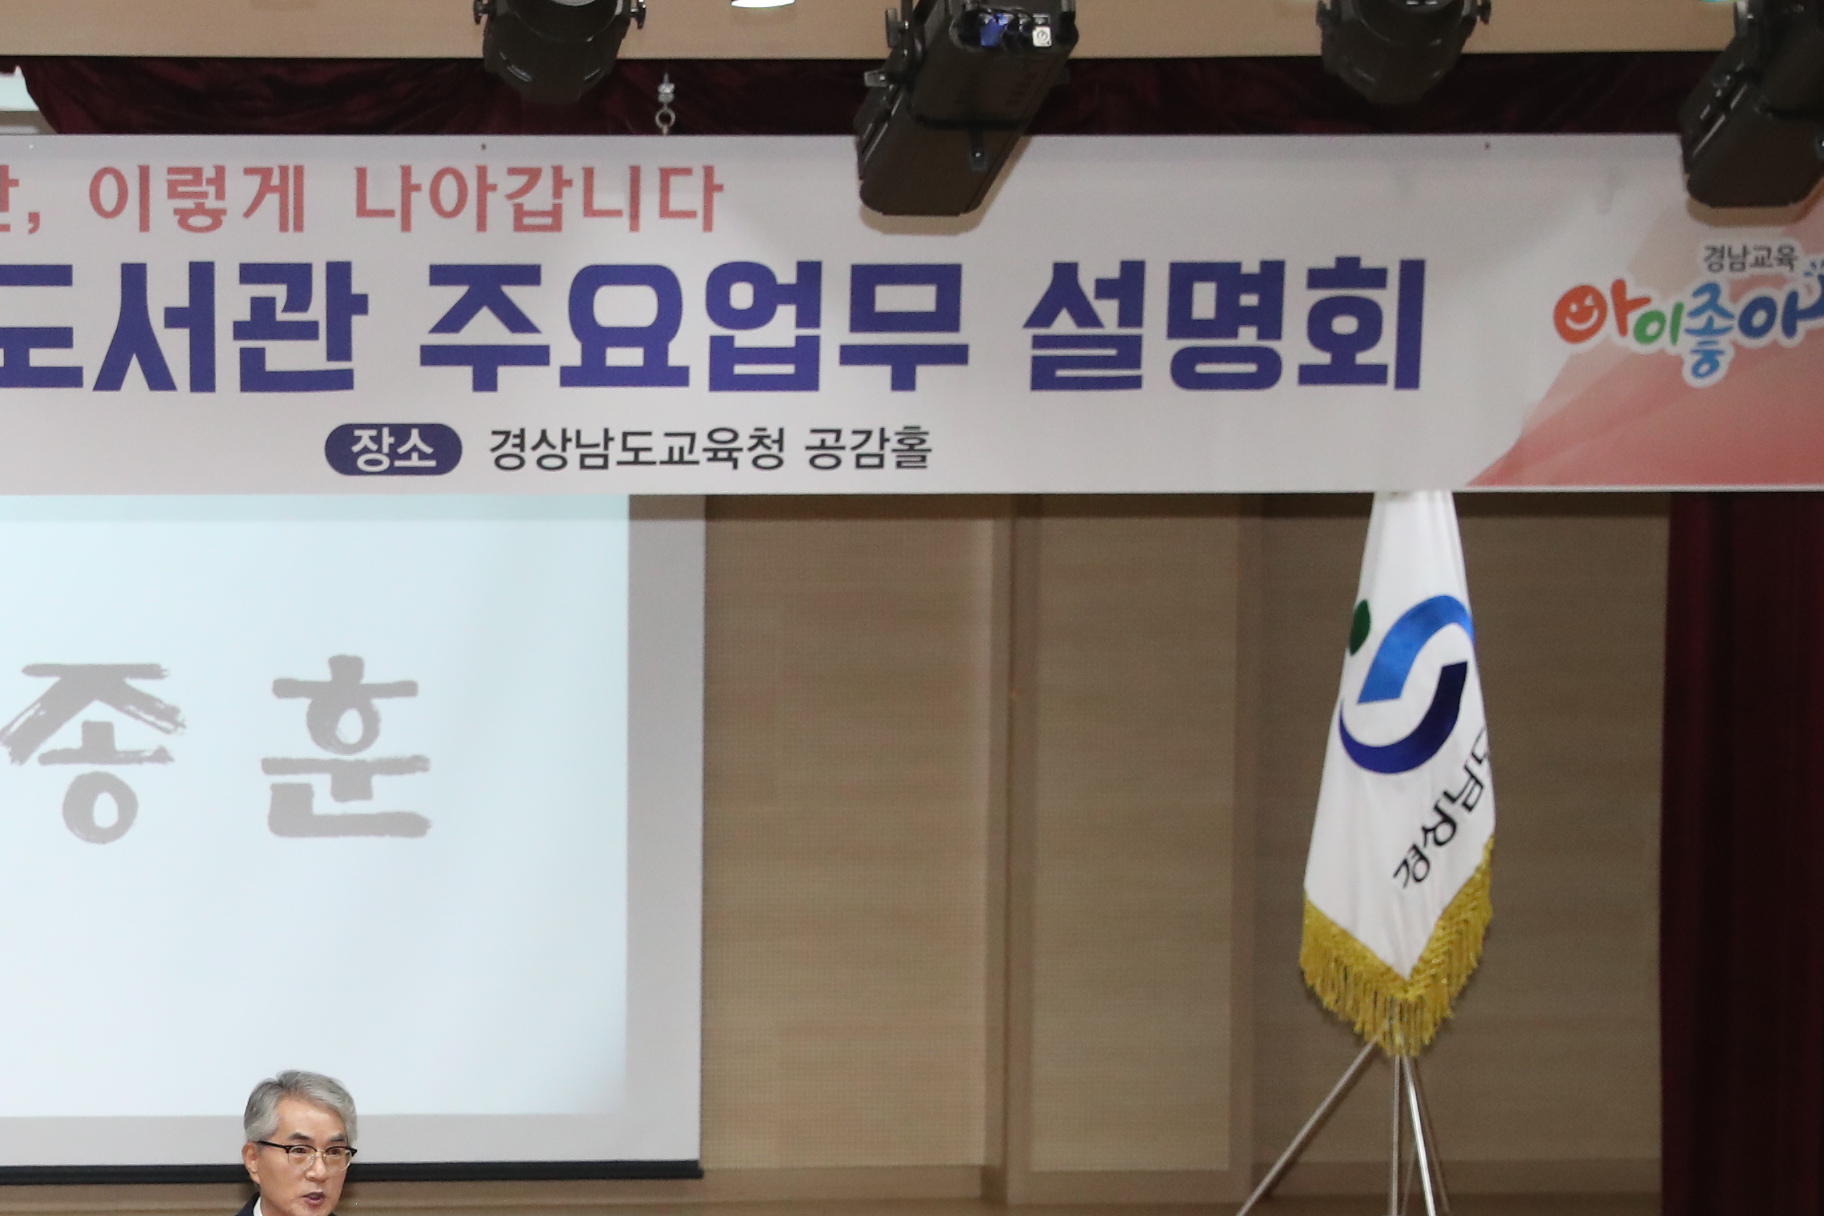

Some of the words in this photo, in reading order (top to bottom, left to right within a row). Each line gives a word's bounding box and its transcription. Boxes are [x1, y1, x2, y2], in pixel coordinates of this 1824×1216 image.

[88, 164, 306, 235] 이렇게
[355, 164, 725, 233] 나아갑니다
[1703, 243, 1798, 273] 경남교육
[419, 261, 971, 394] 주요업무
[1022, 254, 1426, 392] 설명회
[349, 427, 438, 473] 장소
[489, 426, 787, 473] 경상남도교육청
[805, 426, 934, 473] 공감홀
